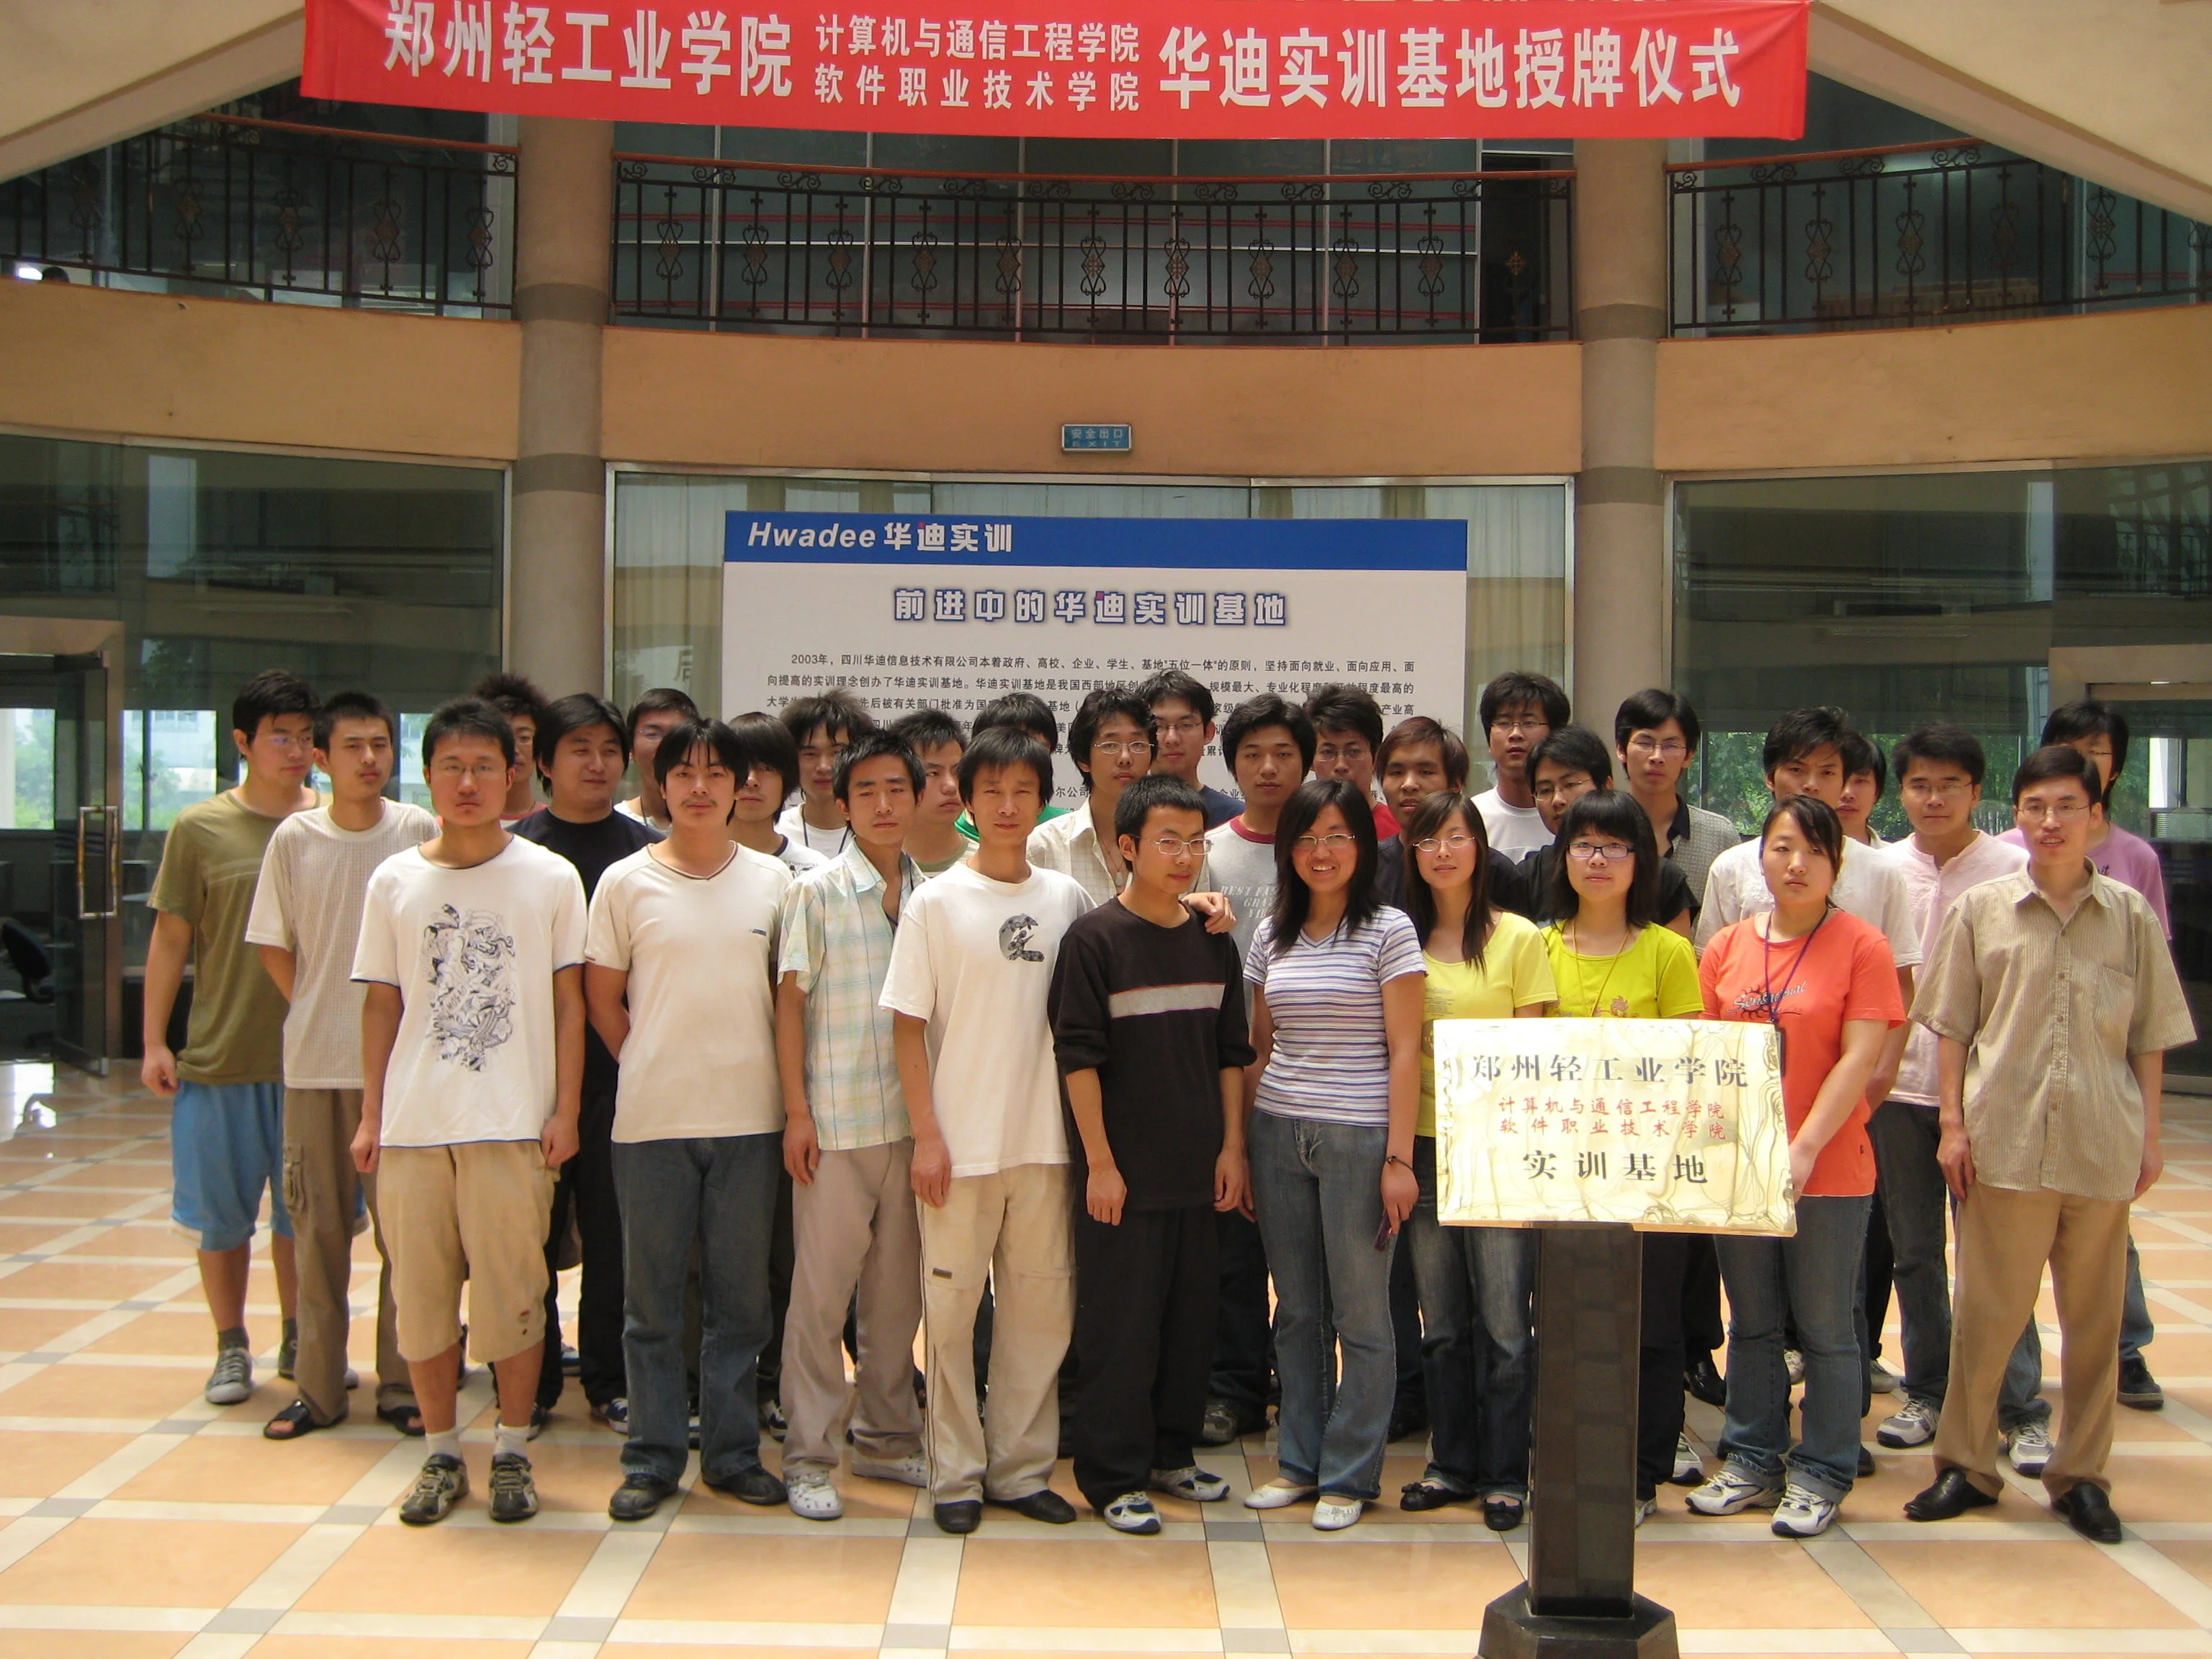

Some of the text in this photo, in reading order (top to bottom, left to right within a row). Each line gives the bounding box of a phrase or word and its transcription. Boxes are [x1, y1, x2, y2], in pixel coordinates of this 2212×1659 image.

[384, 0, 792, 98] 郑州轻工业学院
[815, 14, 1140, 63] 计算机与通信工程学院
[1158, 26, 1741, 109] 华迪实训基地授牌仪式
[814, 63, 1139, 112] 软件职业技术学院
[1071, 428, 1123, 439] 安全出口
[747, 521, 1013, 553] Hwadee 华迪实训
[894, 588, 1287, 626] 前进中的华迪实训基地
[766, 695, 796, 708] 大学
[860, 697, 991, 711] 先后被有关部门批准为国
[1381, 703, 1415, 716] 产业高
[1055, 786, 1089, 799] 尔公司
[1471, 1054, 1748, 1087] 郑州轻工业学院
[1498, 1096, 1725, 1119] 计算机与通信工程学院
[1499, 1116, 1727, 1140] 软件职业技术学院
[1523, 1150, 1709, 1184] 实训基地
